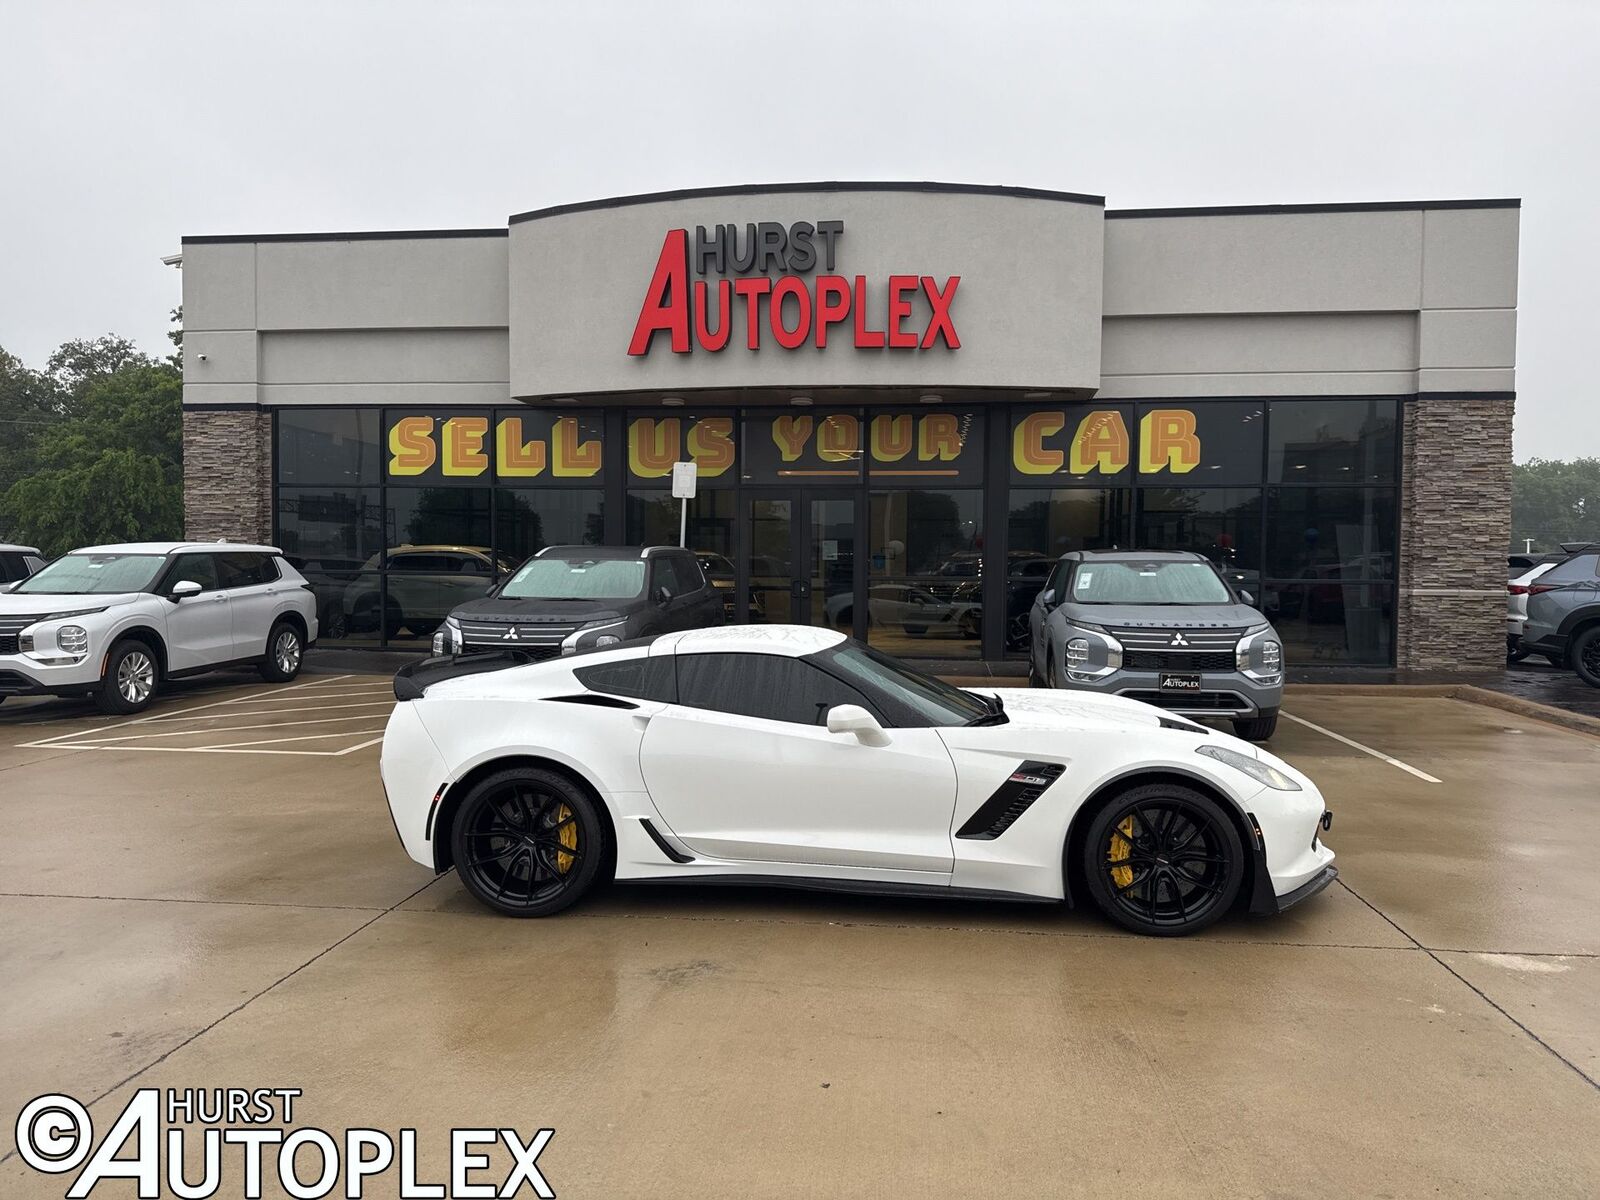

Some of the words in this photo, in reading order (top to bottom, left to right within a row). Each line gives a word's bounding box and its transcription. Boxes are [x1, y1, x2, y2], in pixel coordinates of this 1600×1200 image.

[696, 220, 844, 275] HURST
[627, 228, 962, 356] AUTOPLEX
[389, 416, 602, 477] SELL
[628, 416, 736, 478] US
[772, 414, 961, 462] YOUR
[1013, 409, 1201, 475] CAR
[1162, 678, 1200, 688] AUTOPLEX
